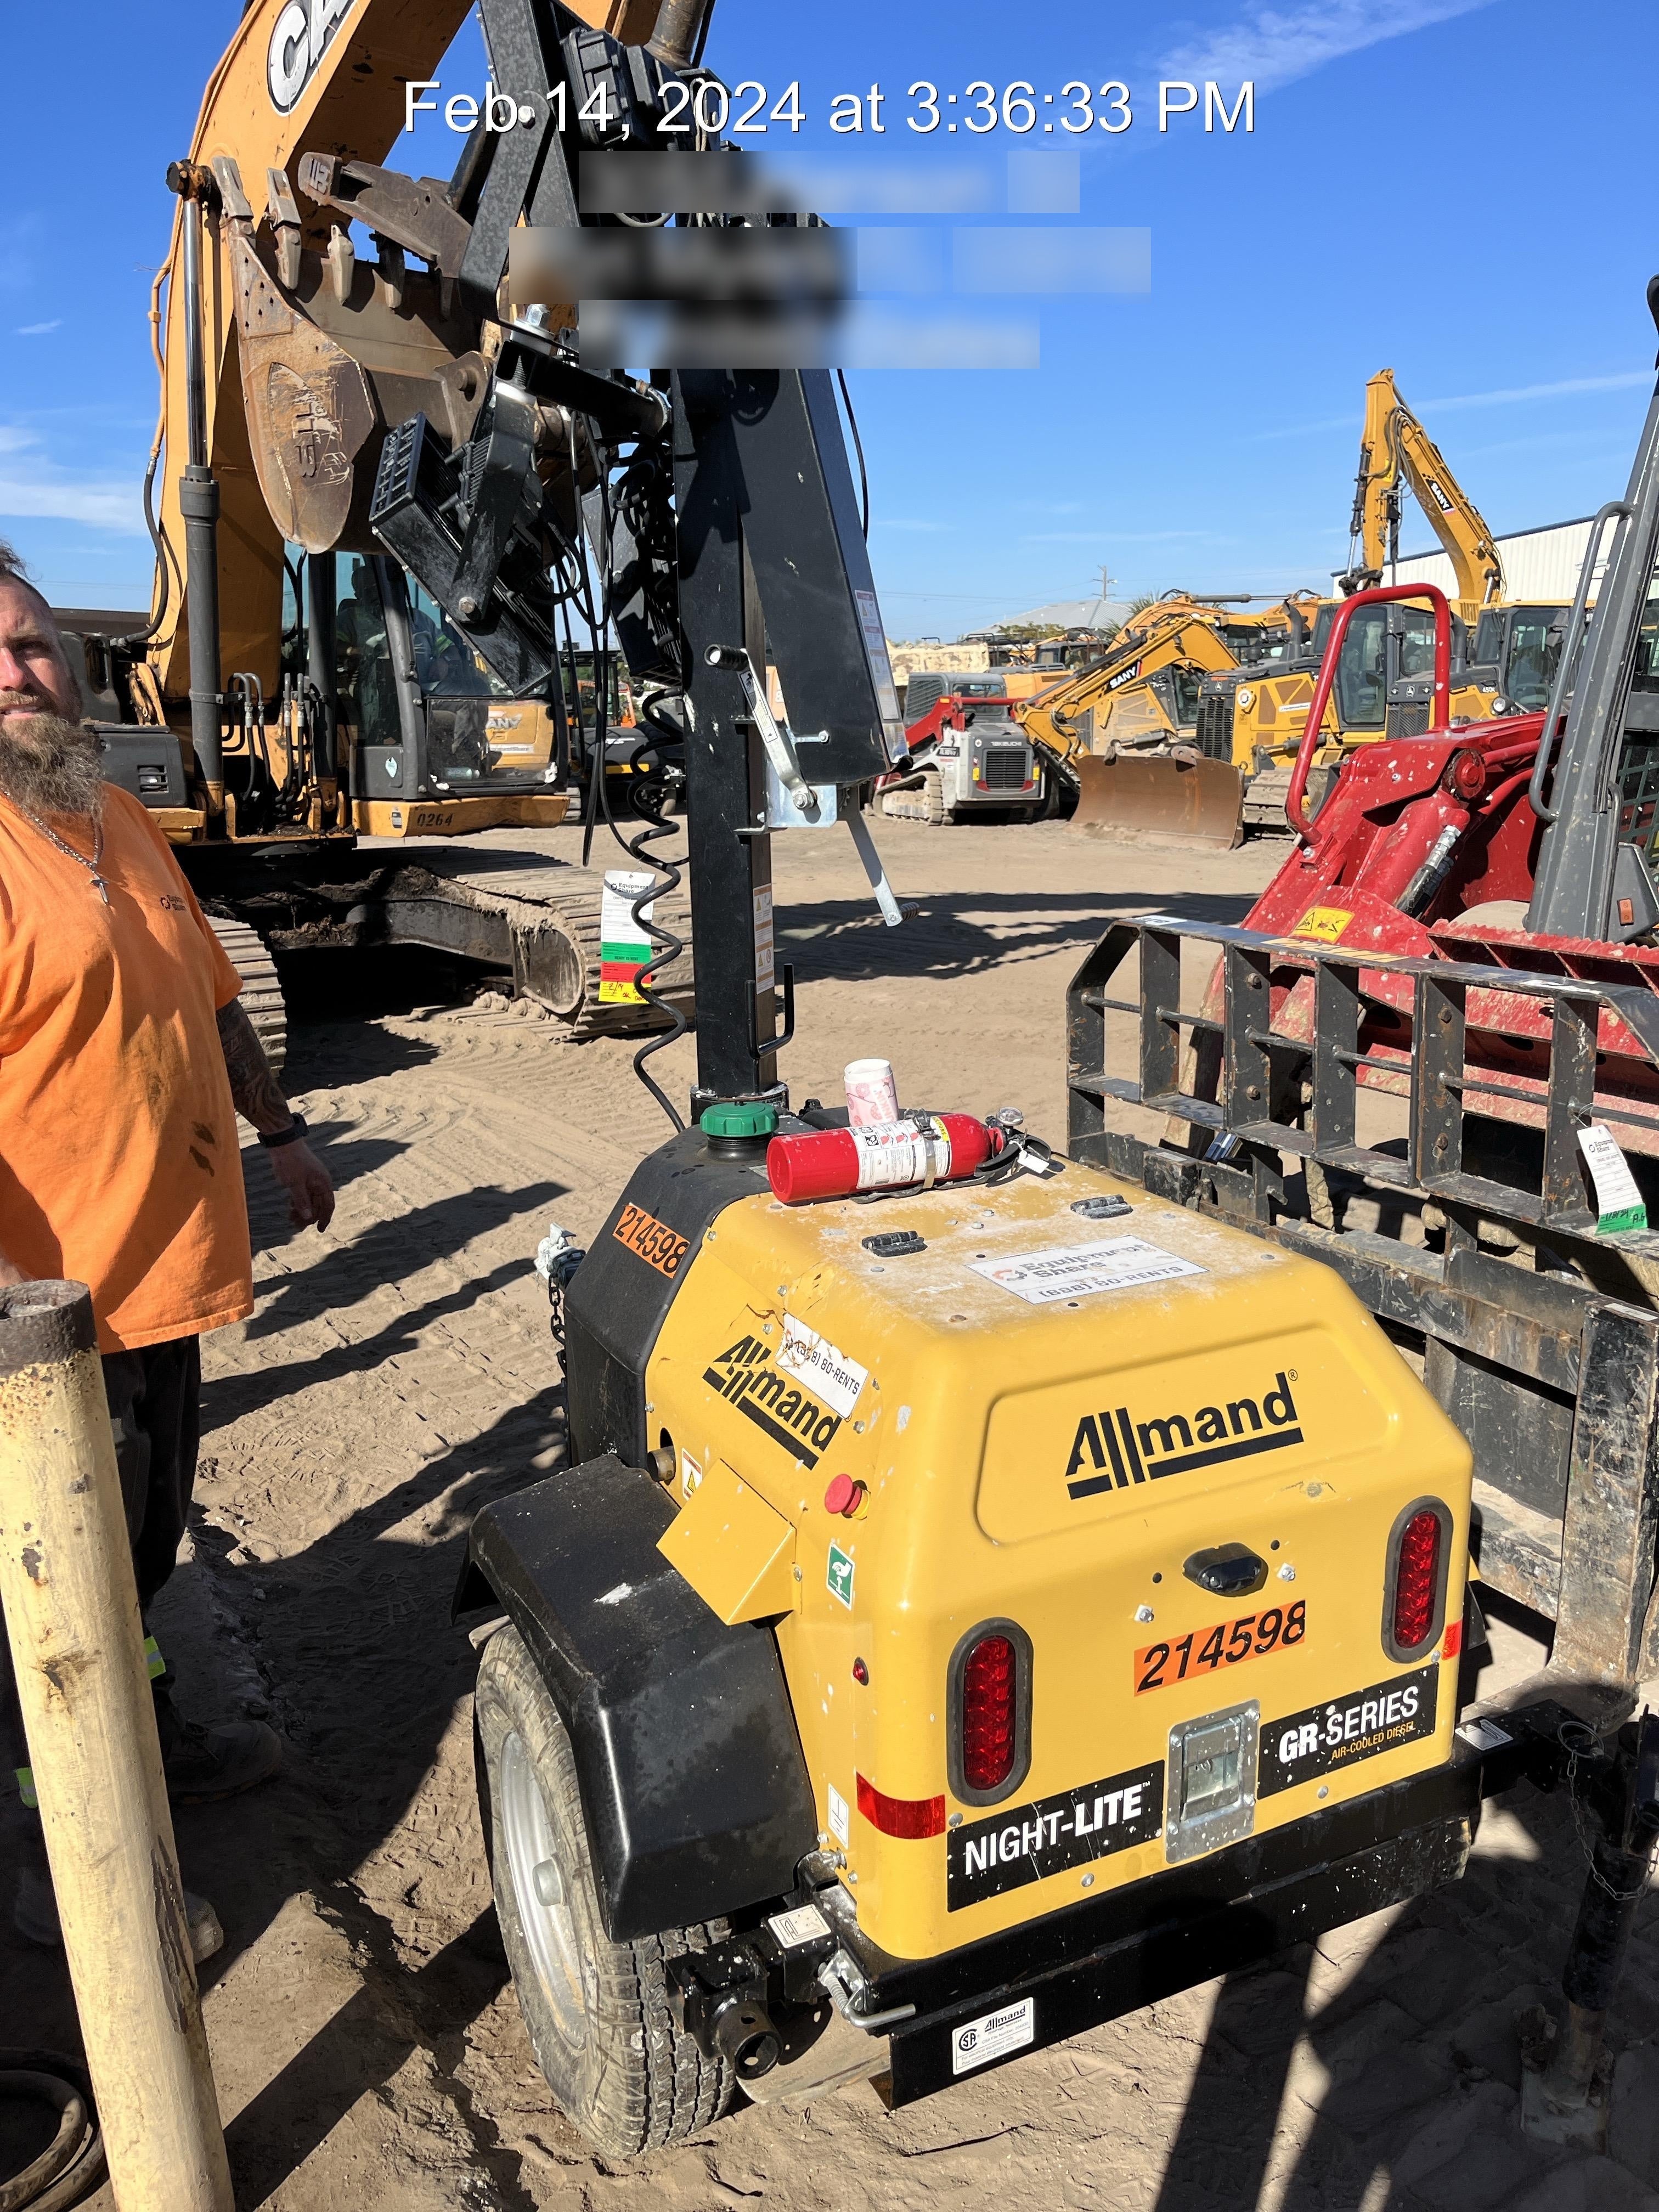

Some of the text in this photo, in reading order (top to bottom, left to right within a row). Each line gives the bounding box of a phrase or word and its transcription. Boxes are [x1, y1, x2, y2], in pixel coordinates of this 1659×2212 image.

[1431, 483, 1449, 509] SANY
[1109, 666, 1137, 689] SANY
[417, 813, 453, 827] 0264
[616, 1207, 690, 1273] 214598
[1019, 1244, 1150, 1272] Equipment
[1034, 1260, 1107, 1278] Share
[1039, 1266, 1183, 1297] (888) 80-RENTS
[820, 1357, 860, 1395] 80-RENTS
[713, 1335, 843, 1452] Allmand
[1137, 1600, 1305, 1692] 214598
[1279, 1686, 1418, 1763] GR-SERIES
[1331, 1721, 1416, 1760] AIR-COOLED DIESEL
[985, 2005, 1025, 2030] Allmand
